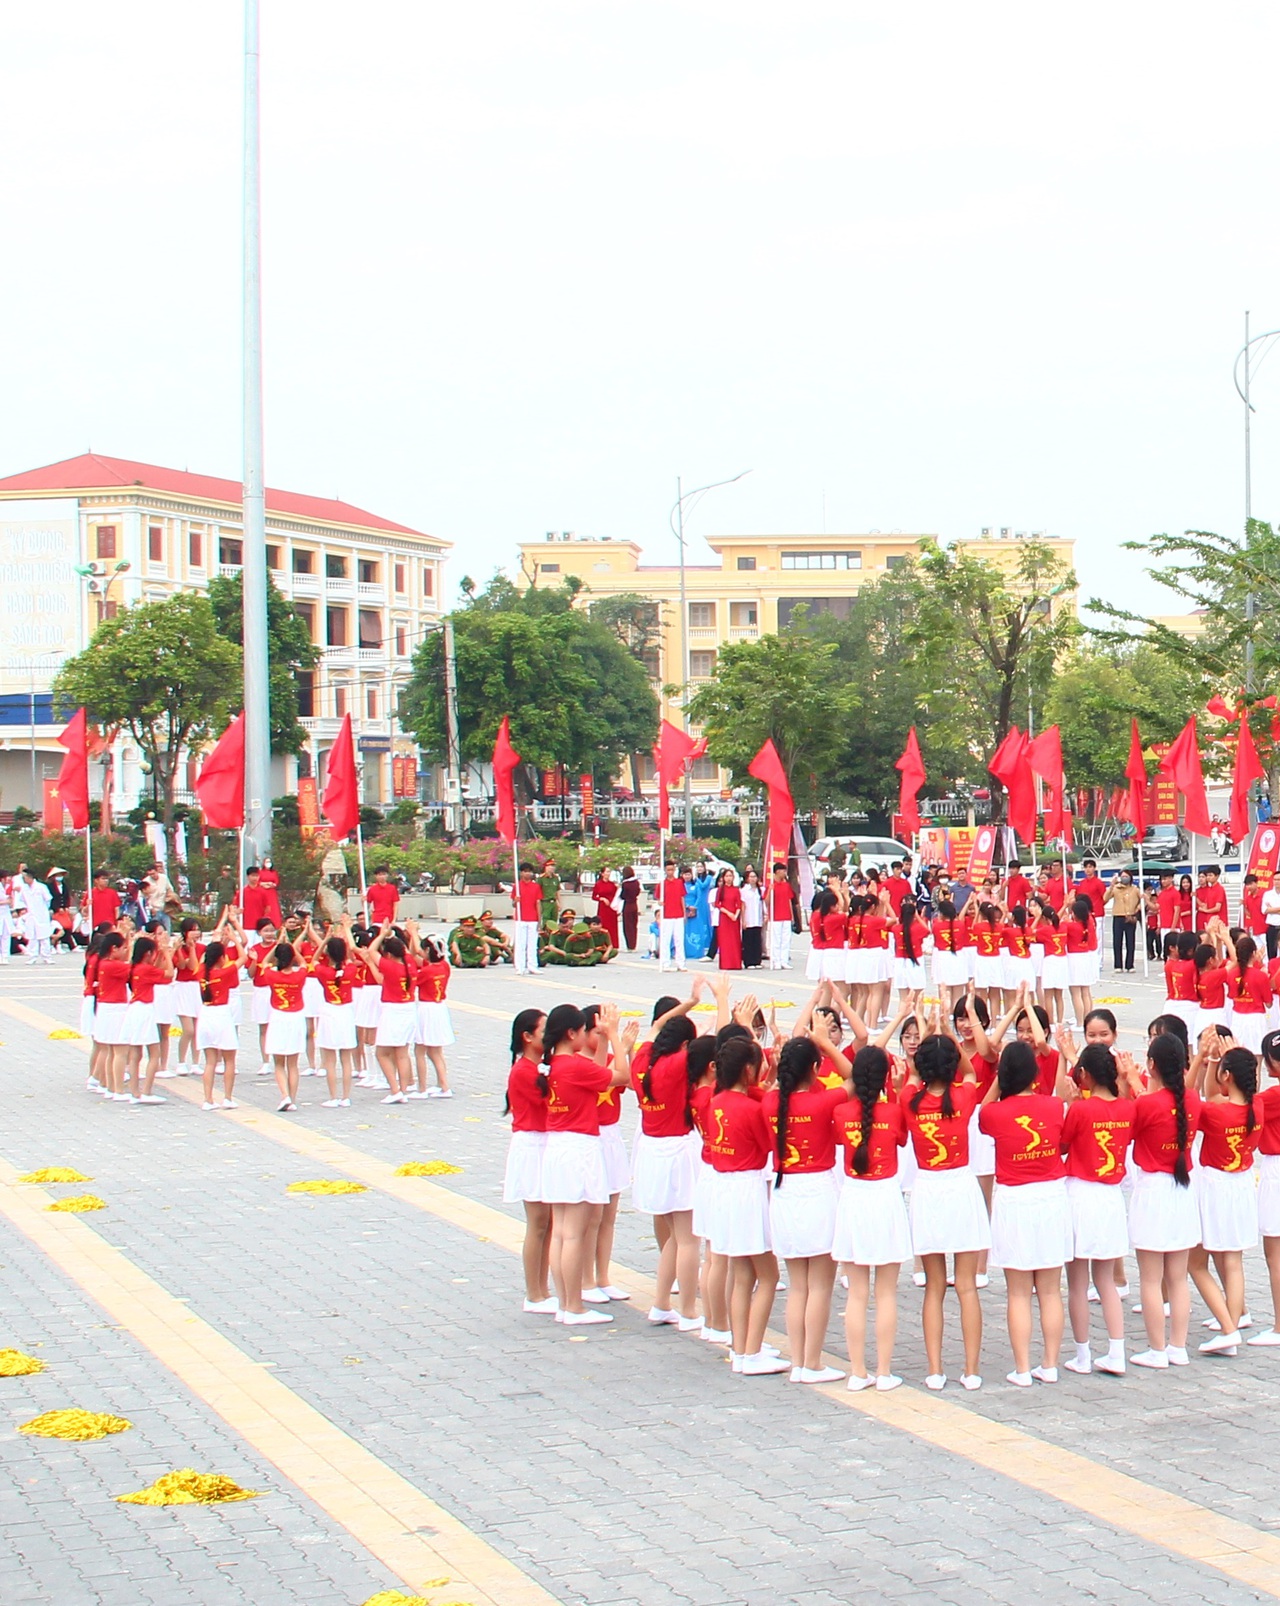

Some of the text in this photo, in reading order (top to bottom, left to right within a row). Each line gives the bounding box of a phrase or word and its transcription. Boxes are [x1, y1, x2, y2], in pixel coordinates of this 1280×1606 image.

[794, 1115, 812, 1123] NAM
[926, 1112, 943, 1122] VIỆT
[1101, 1120, 1117, 1130] VIỆT
[1116, 1121, 1130, 1129] NAM
[1023, 1150, 1041, 1160] VIỆT
[1041, 1147, 1057, 1158] NAM
